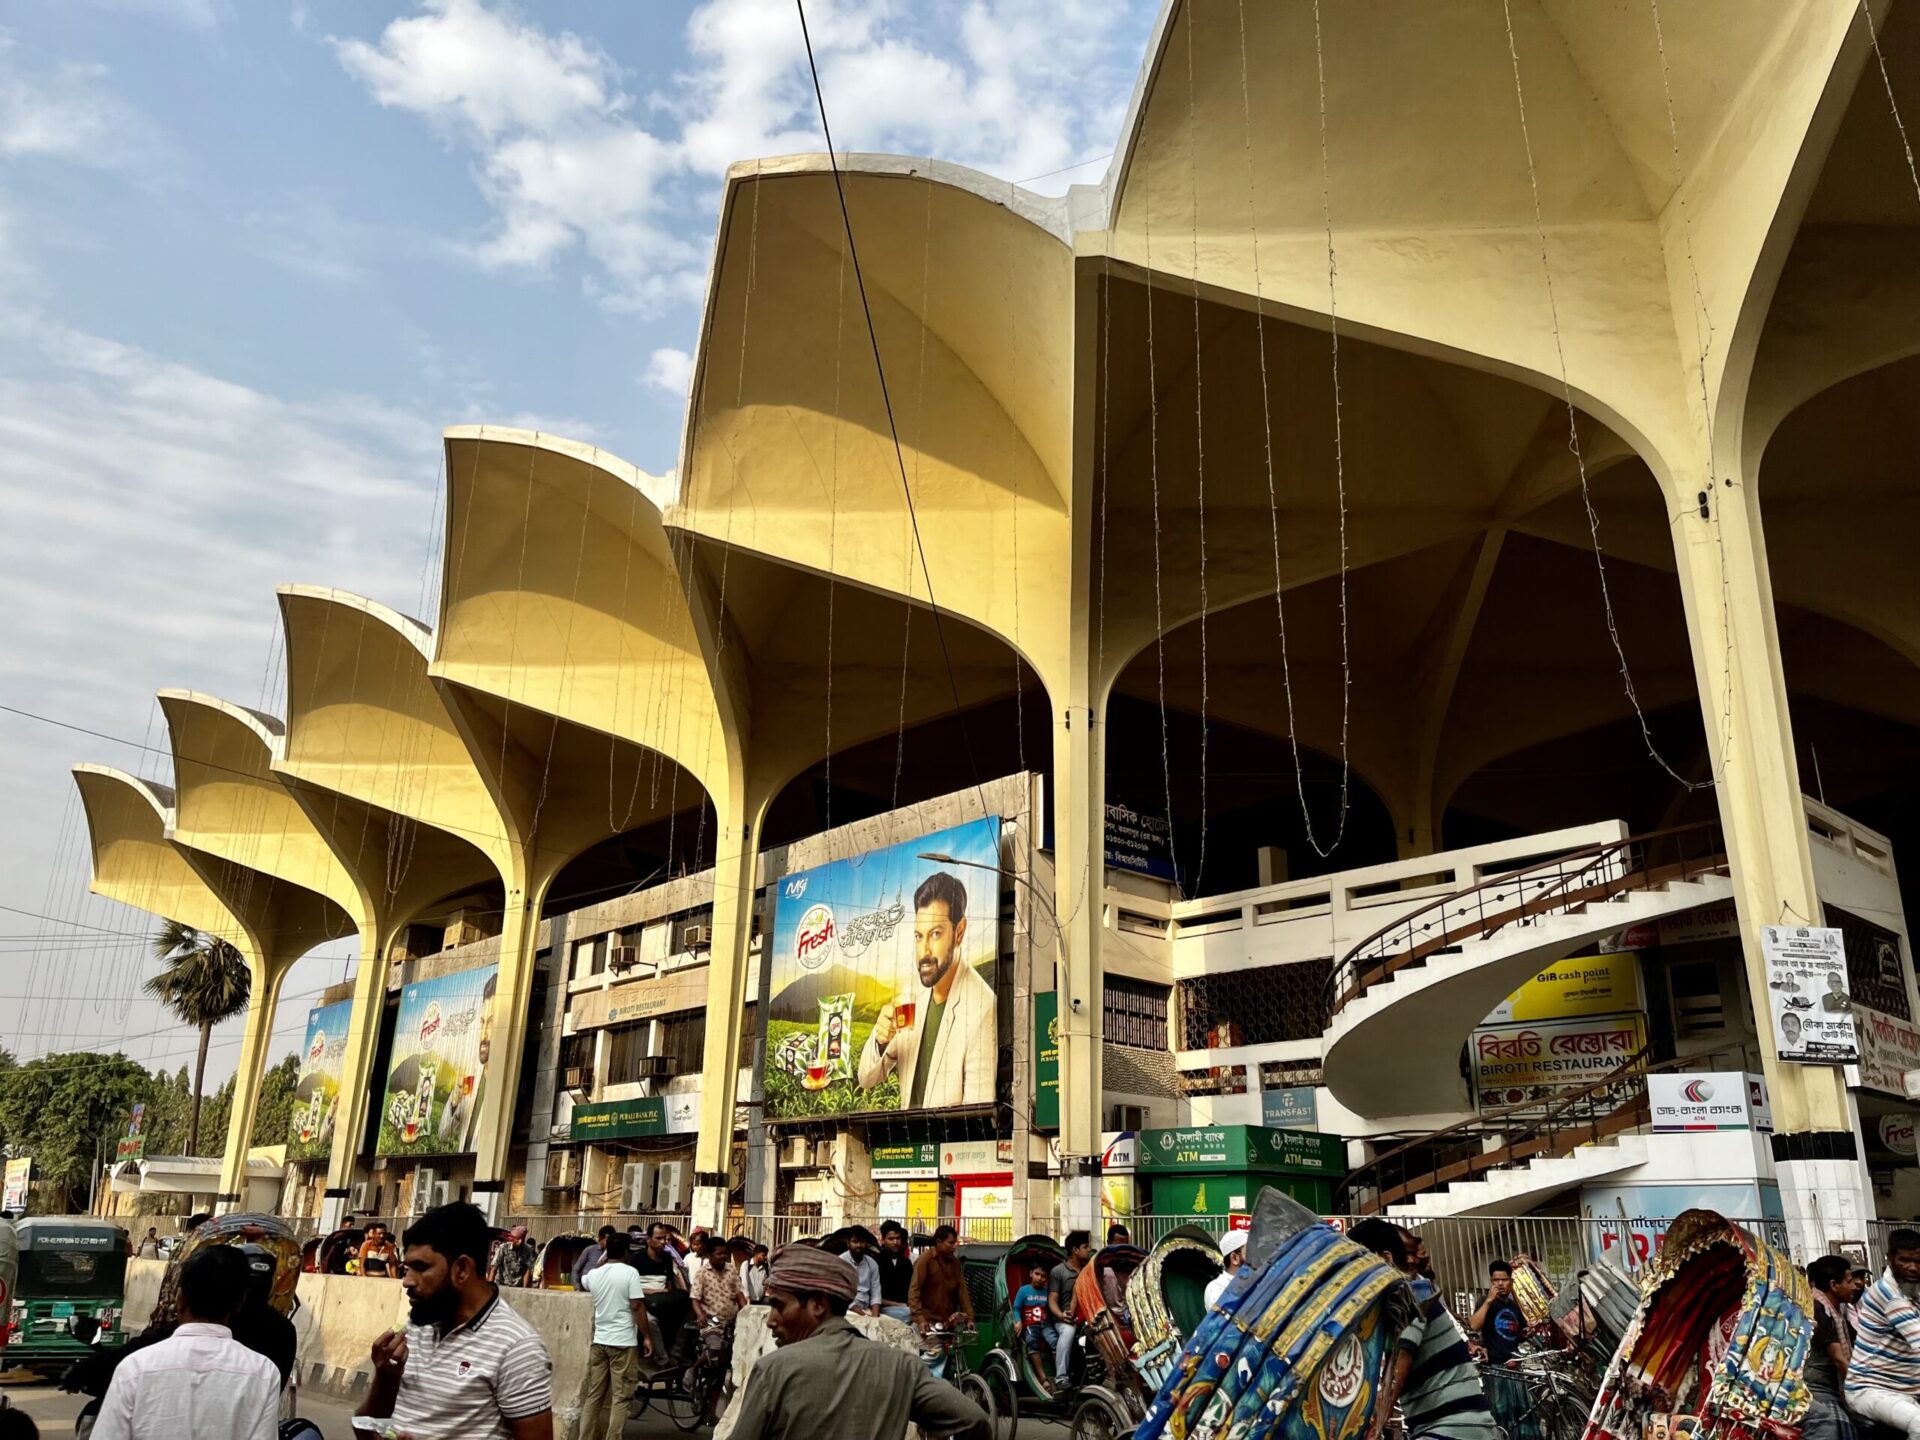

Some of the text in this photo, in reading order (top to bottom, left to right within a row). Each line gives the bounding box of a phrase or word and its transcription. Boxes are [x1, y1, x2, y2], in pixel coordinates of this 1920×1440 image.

[798, 918, 834, 959] Fresh
[1559, 970, 1581, 980] cash
[1583, 968, 1610, 983] point
[1477, 1031, 1543, 1061] বিরতি
[1481, 1062, 1528, 1076] BIROTI
[1265, 1107, 1312, 1118] TRANSFAST
[1176, 1130, 1225, 1144] ইসলামী ব্যাংক
[921, 1154, 934, 1162] CRM
[1112, 1153, 1130, 1162] ATM
[1177, 1151, 1198, 1162] ATM
[1285, 1153, 1301, 1165] ATM
